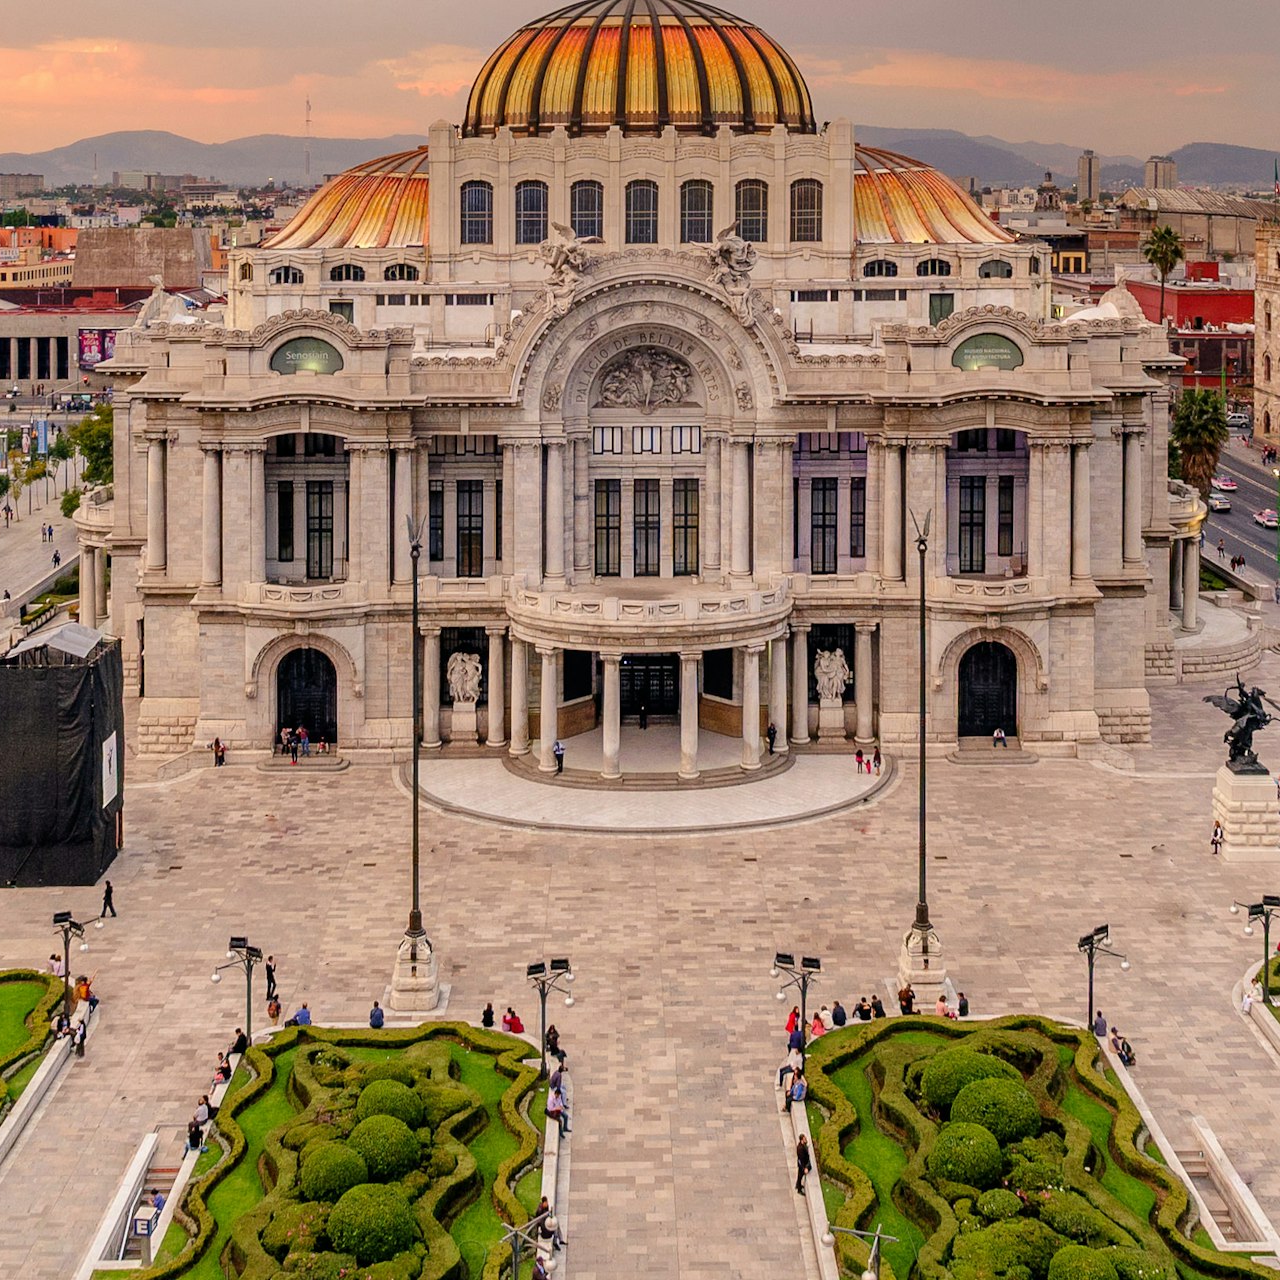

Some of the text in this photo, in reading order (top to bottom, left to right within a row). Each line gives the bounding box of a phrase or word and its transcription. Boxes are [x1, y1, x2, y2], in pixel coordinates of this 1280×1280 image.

[285, 351, 329, 359] Senosiain
[575, 332, 720, 403] PALACIO DE BELLAS ARTES
